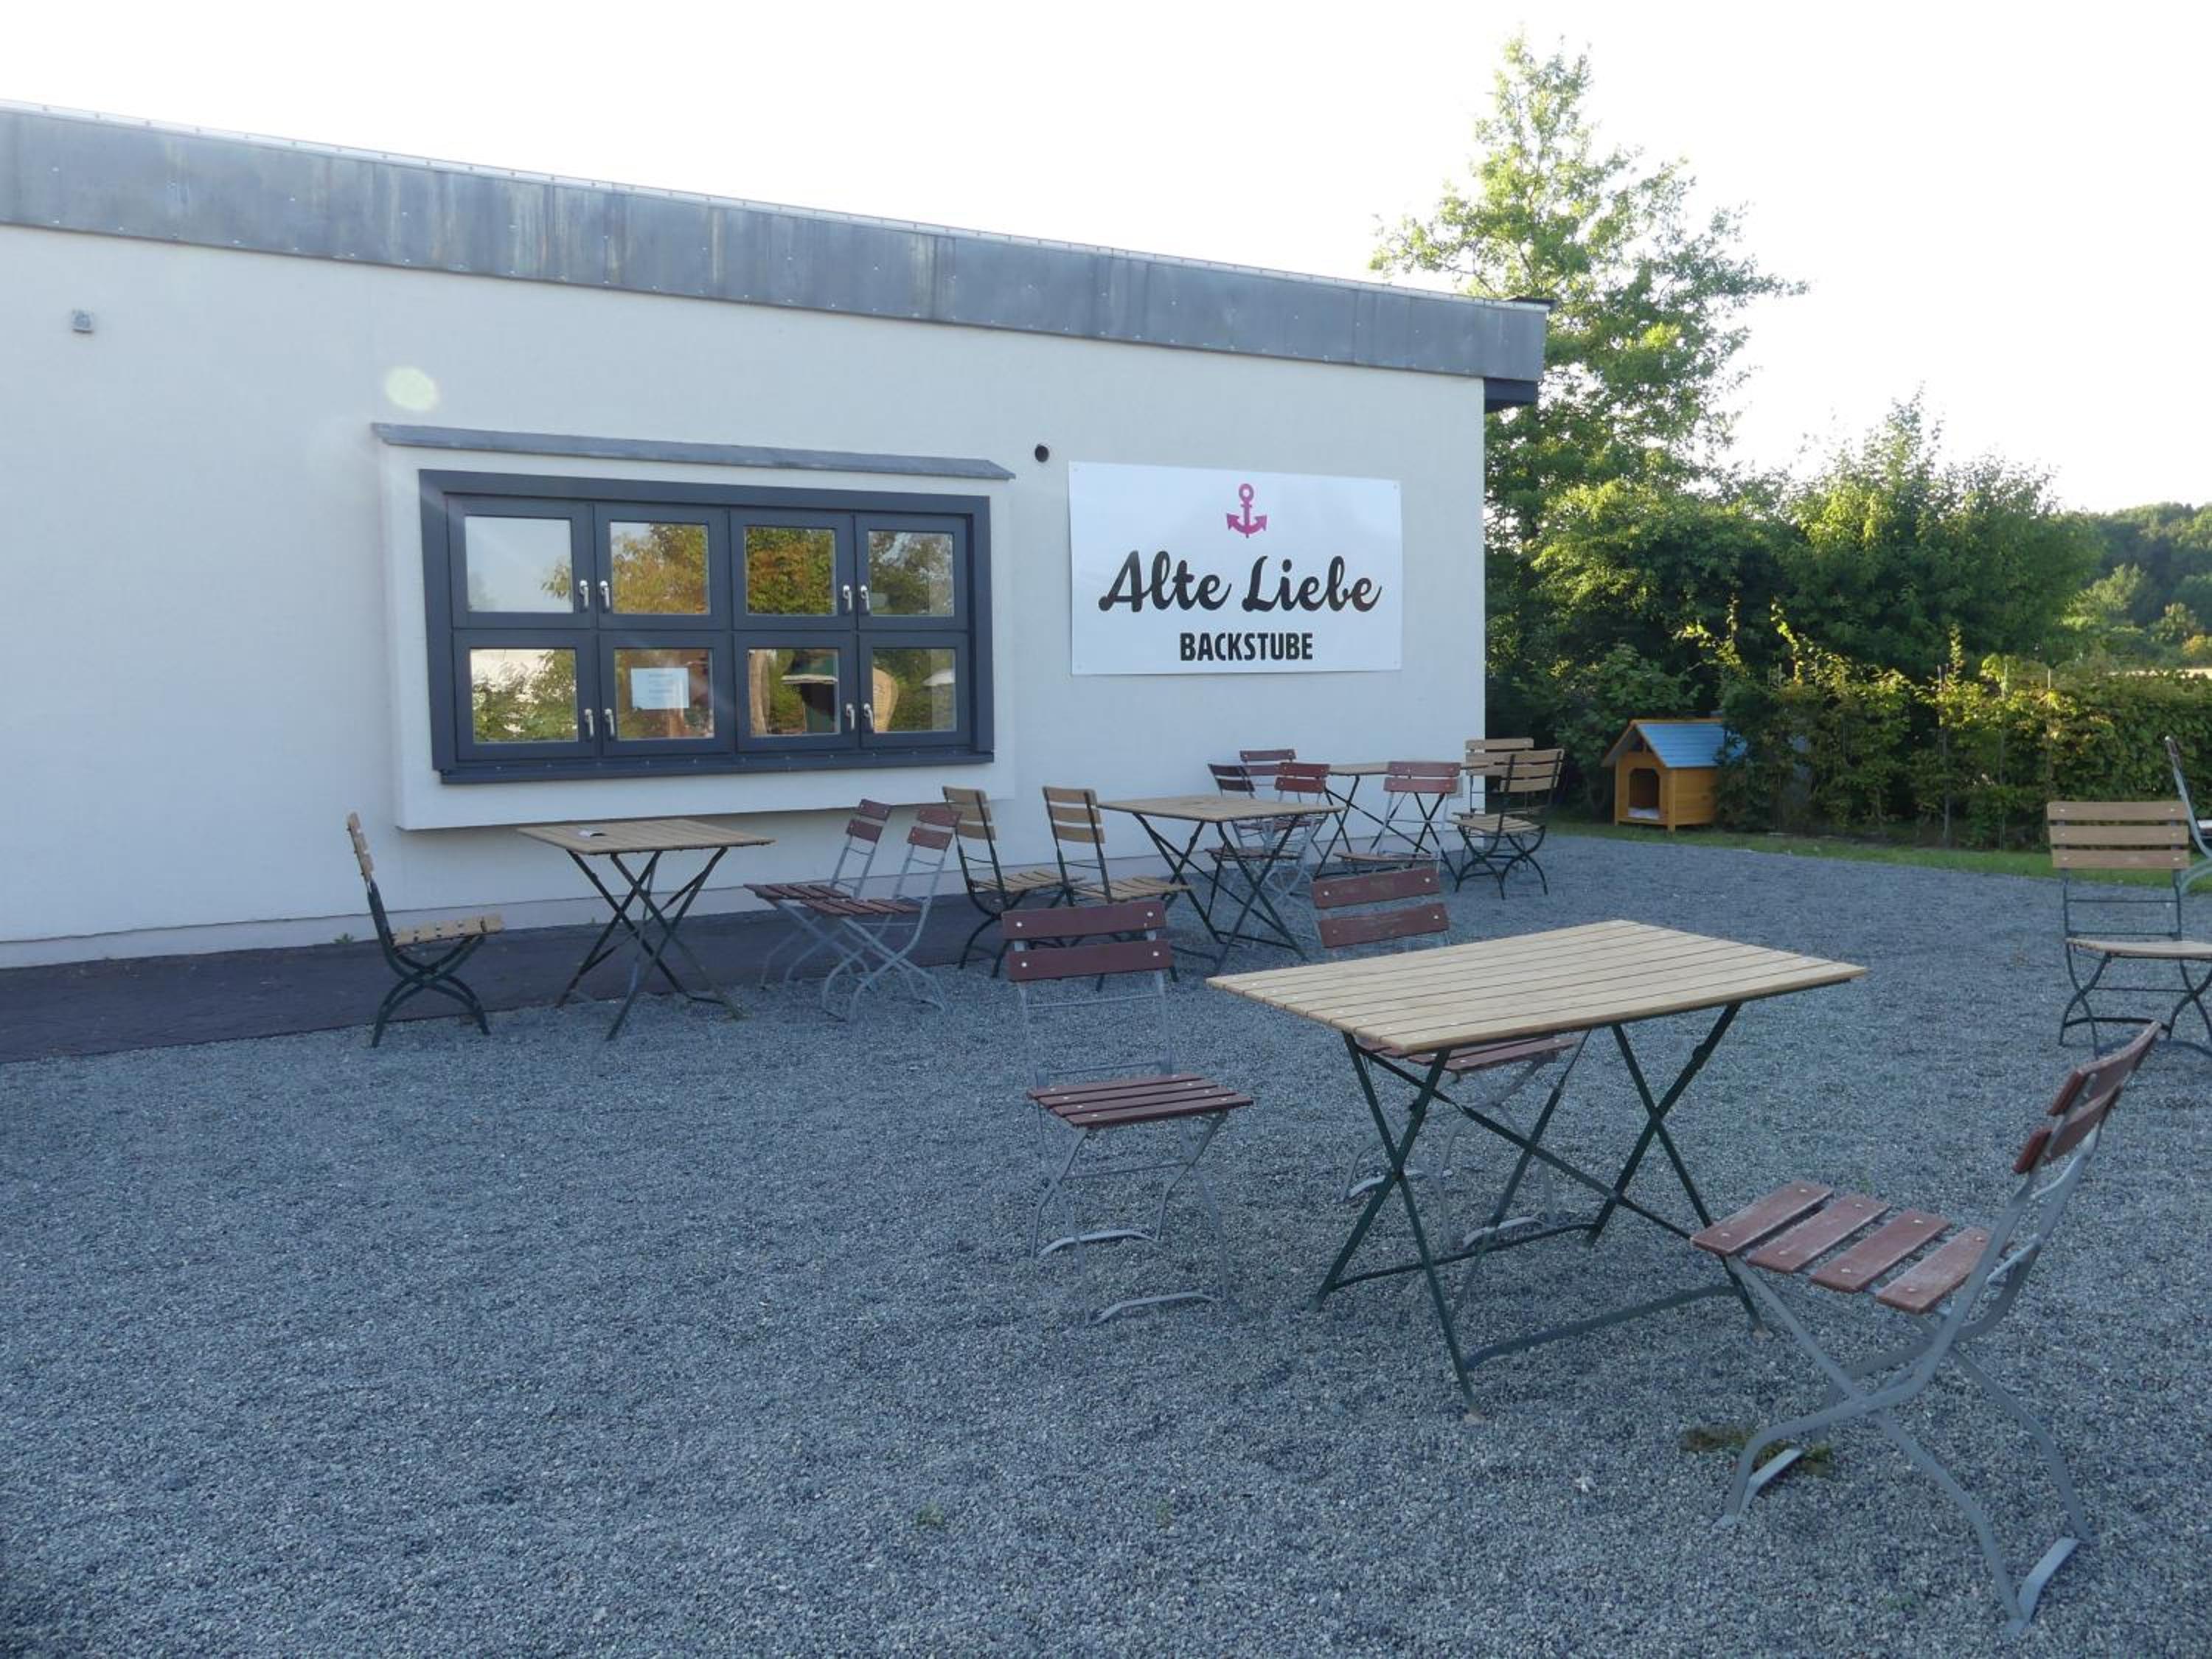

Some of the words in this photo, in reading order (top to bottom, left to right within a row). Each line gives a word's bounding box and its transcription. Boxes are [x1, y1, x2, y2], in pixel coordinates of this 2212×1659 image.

[1098, 550, 1232, 613] Alte
[1242, 555, 1382, 613] Liebe
[1180, 632, 1313, 661] BACKSTUBE
